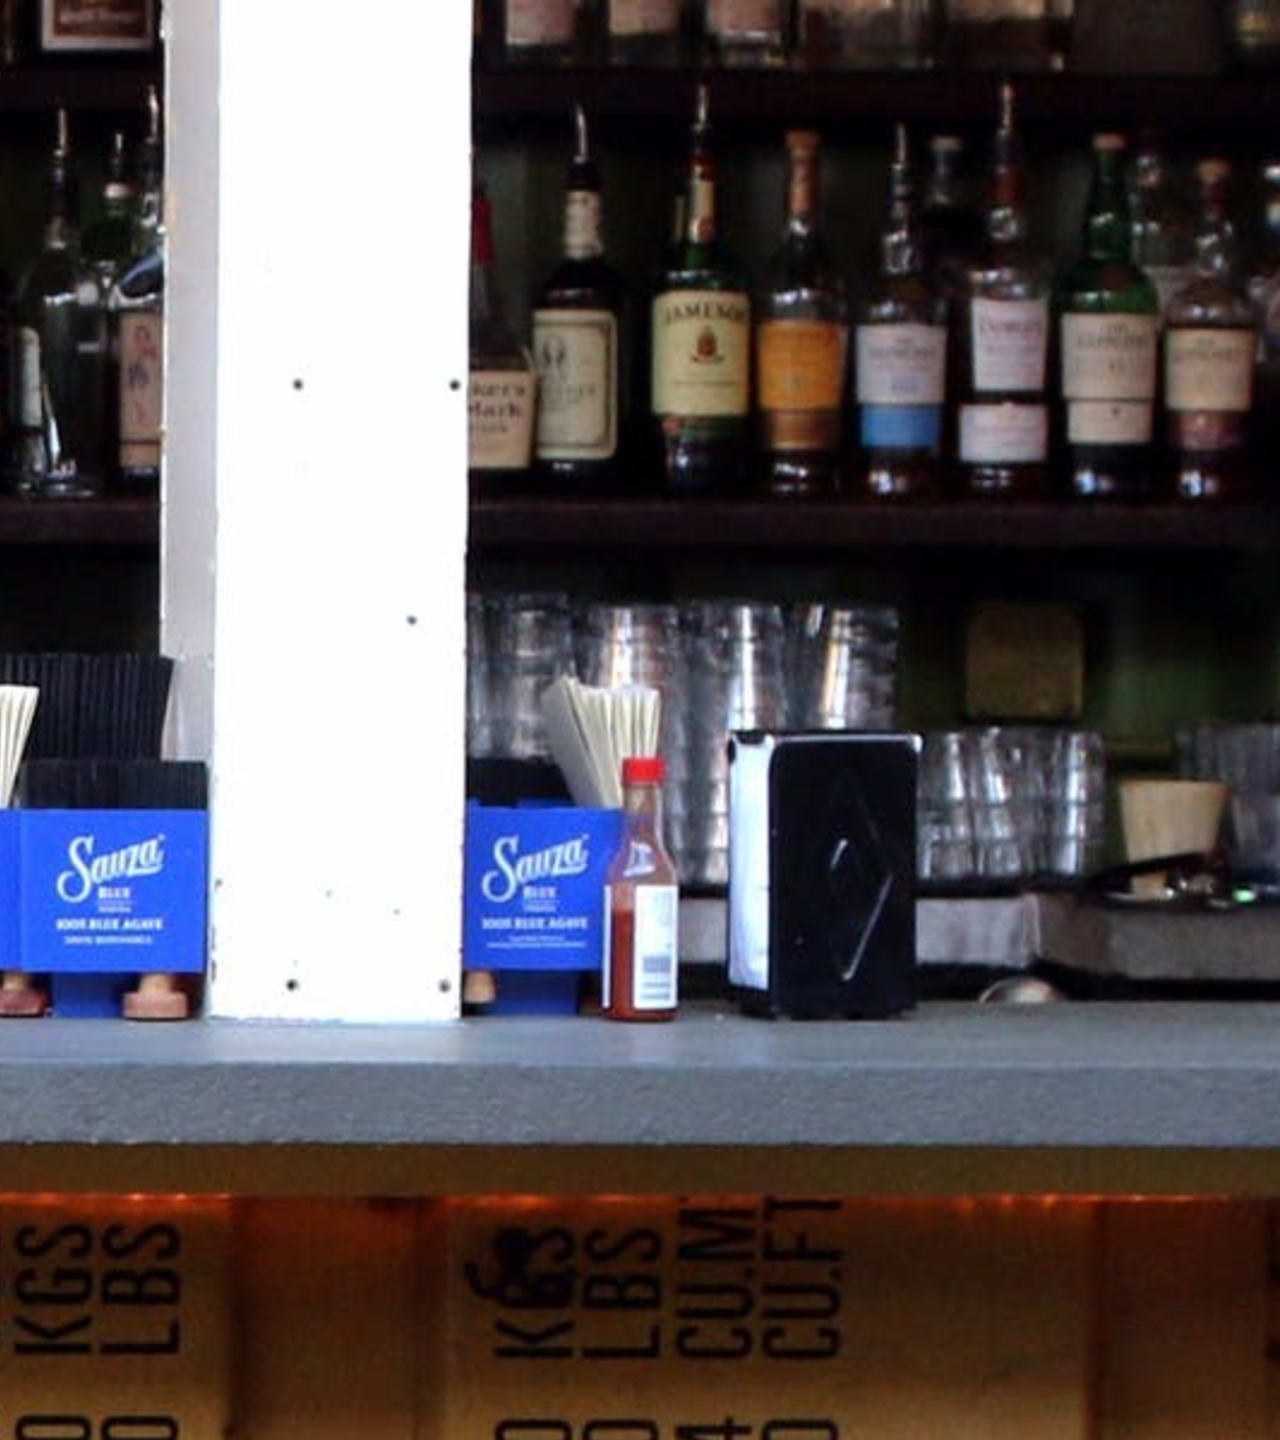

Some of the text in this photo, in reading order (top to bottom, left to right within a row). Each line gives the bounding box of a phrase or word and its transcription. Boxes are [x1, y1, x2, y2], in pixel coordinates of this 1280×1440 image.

[55, 834, 166, 904] Sauza
[482, 834, 589, 904] Sauza
[14, 1223, 93, 1355] KGS
[100, 1222, 181, 1355] LBS
[582, 1228, 662, 1360] LBS
